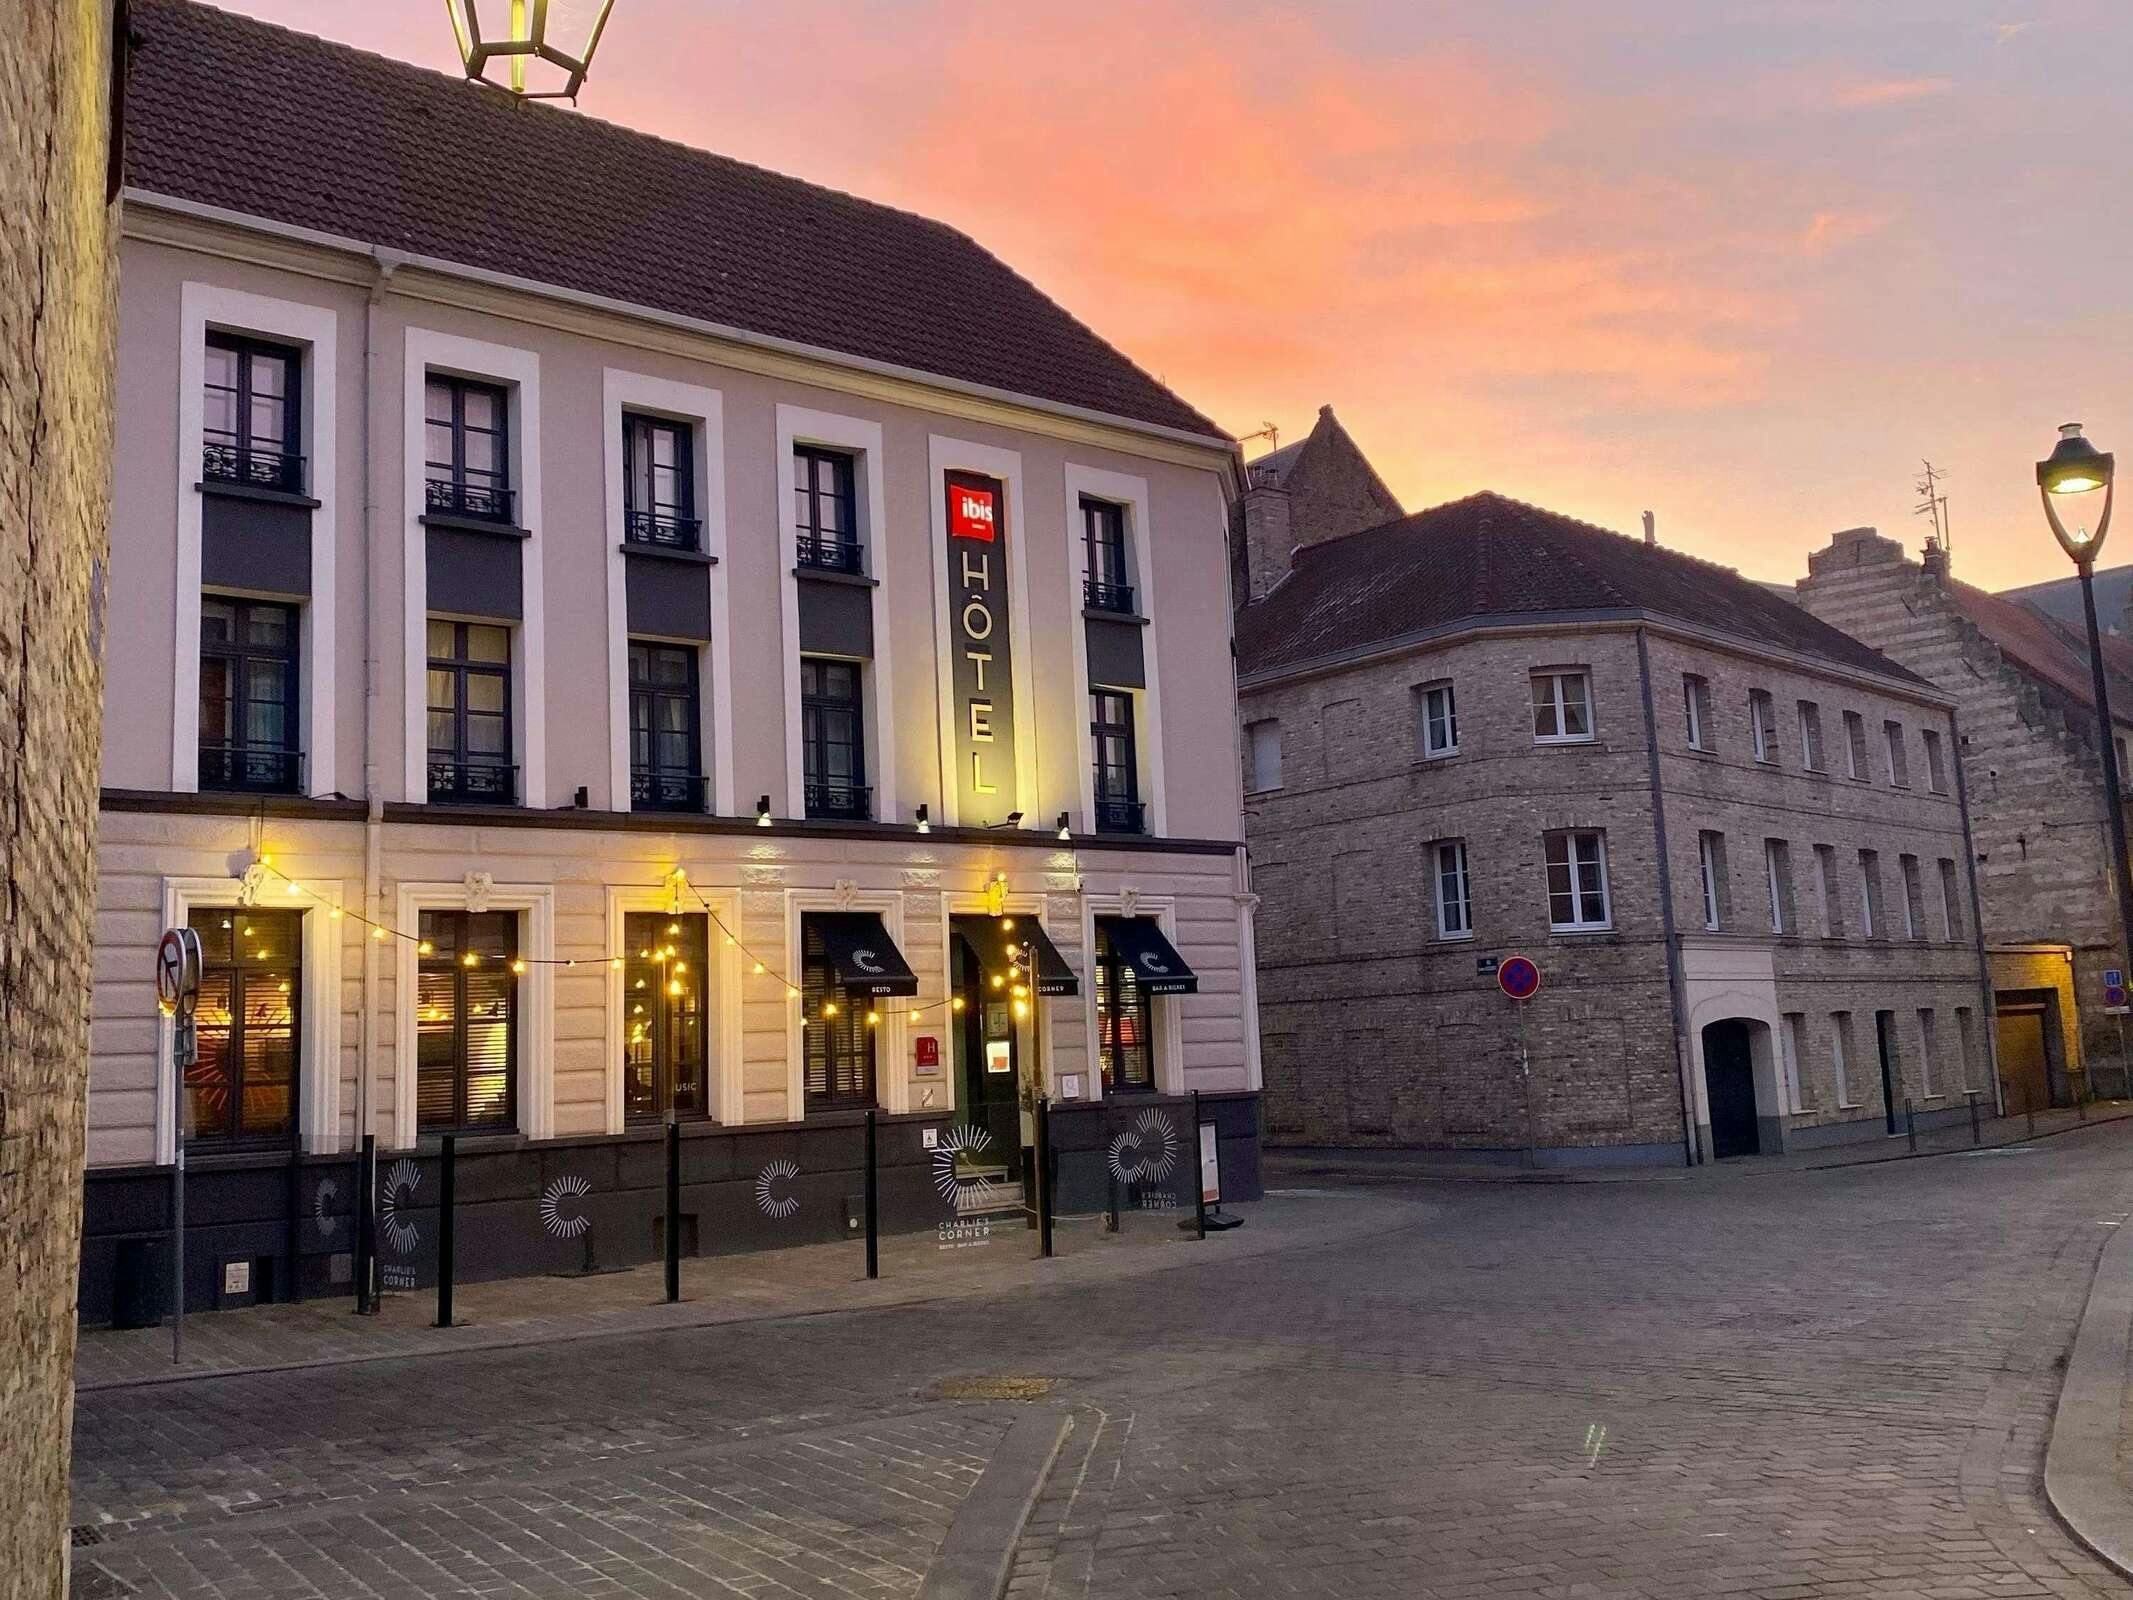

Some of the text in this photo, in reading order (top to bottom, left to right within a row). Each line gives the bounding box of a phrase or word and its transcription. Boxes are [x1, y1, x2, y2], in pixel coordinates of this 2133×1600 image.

[962, 496, 993, 522] ibis
[962, 551, 997, 794] HÔTEL
[927, 1041, 936, 1053] H
[675, 1082, 697, 1092] USIC
[938, 1226, 990, 1241] CORNER
[383, 1275, 416, 1288] CORNER
